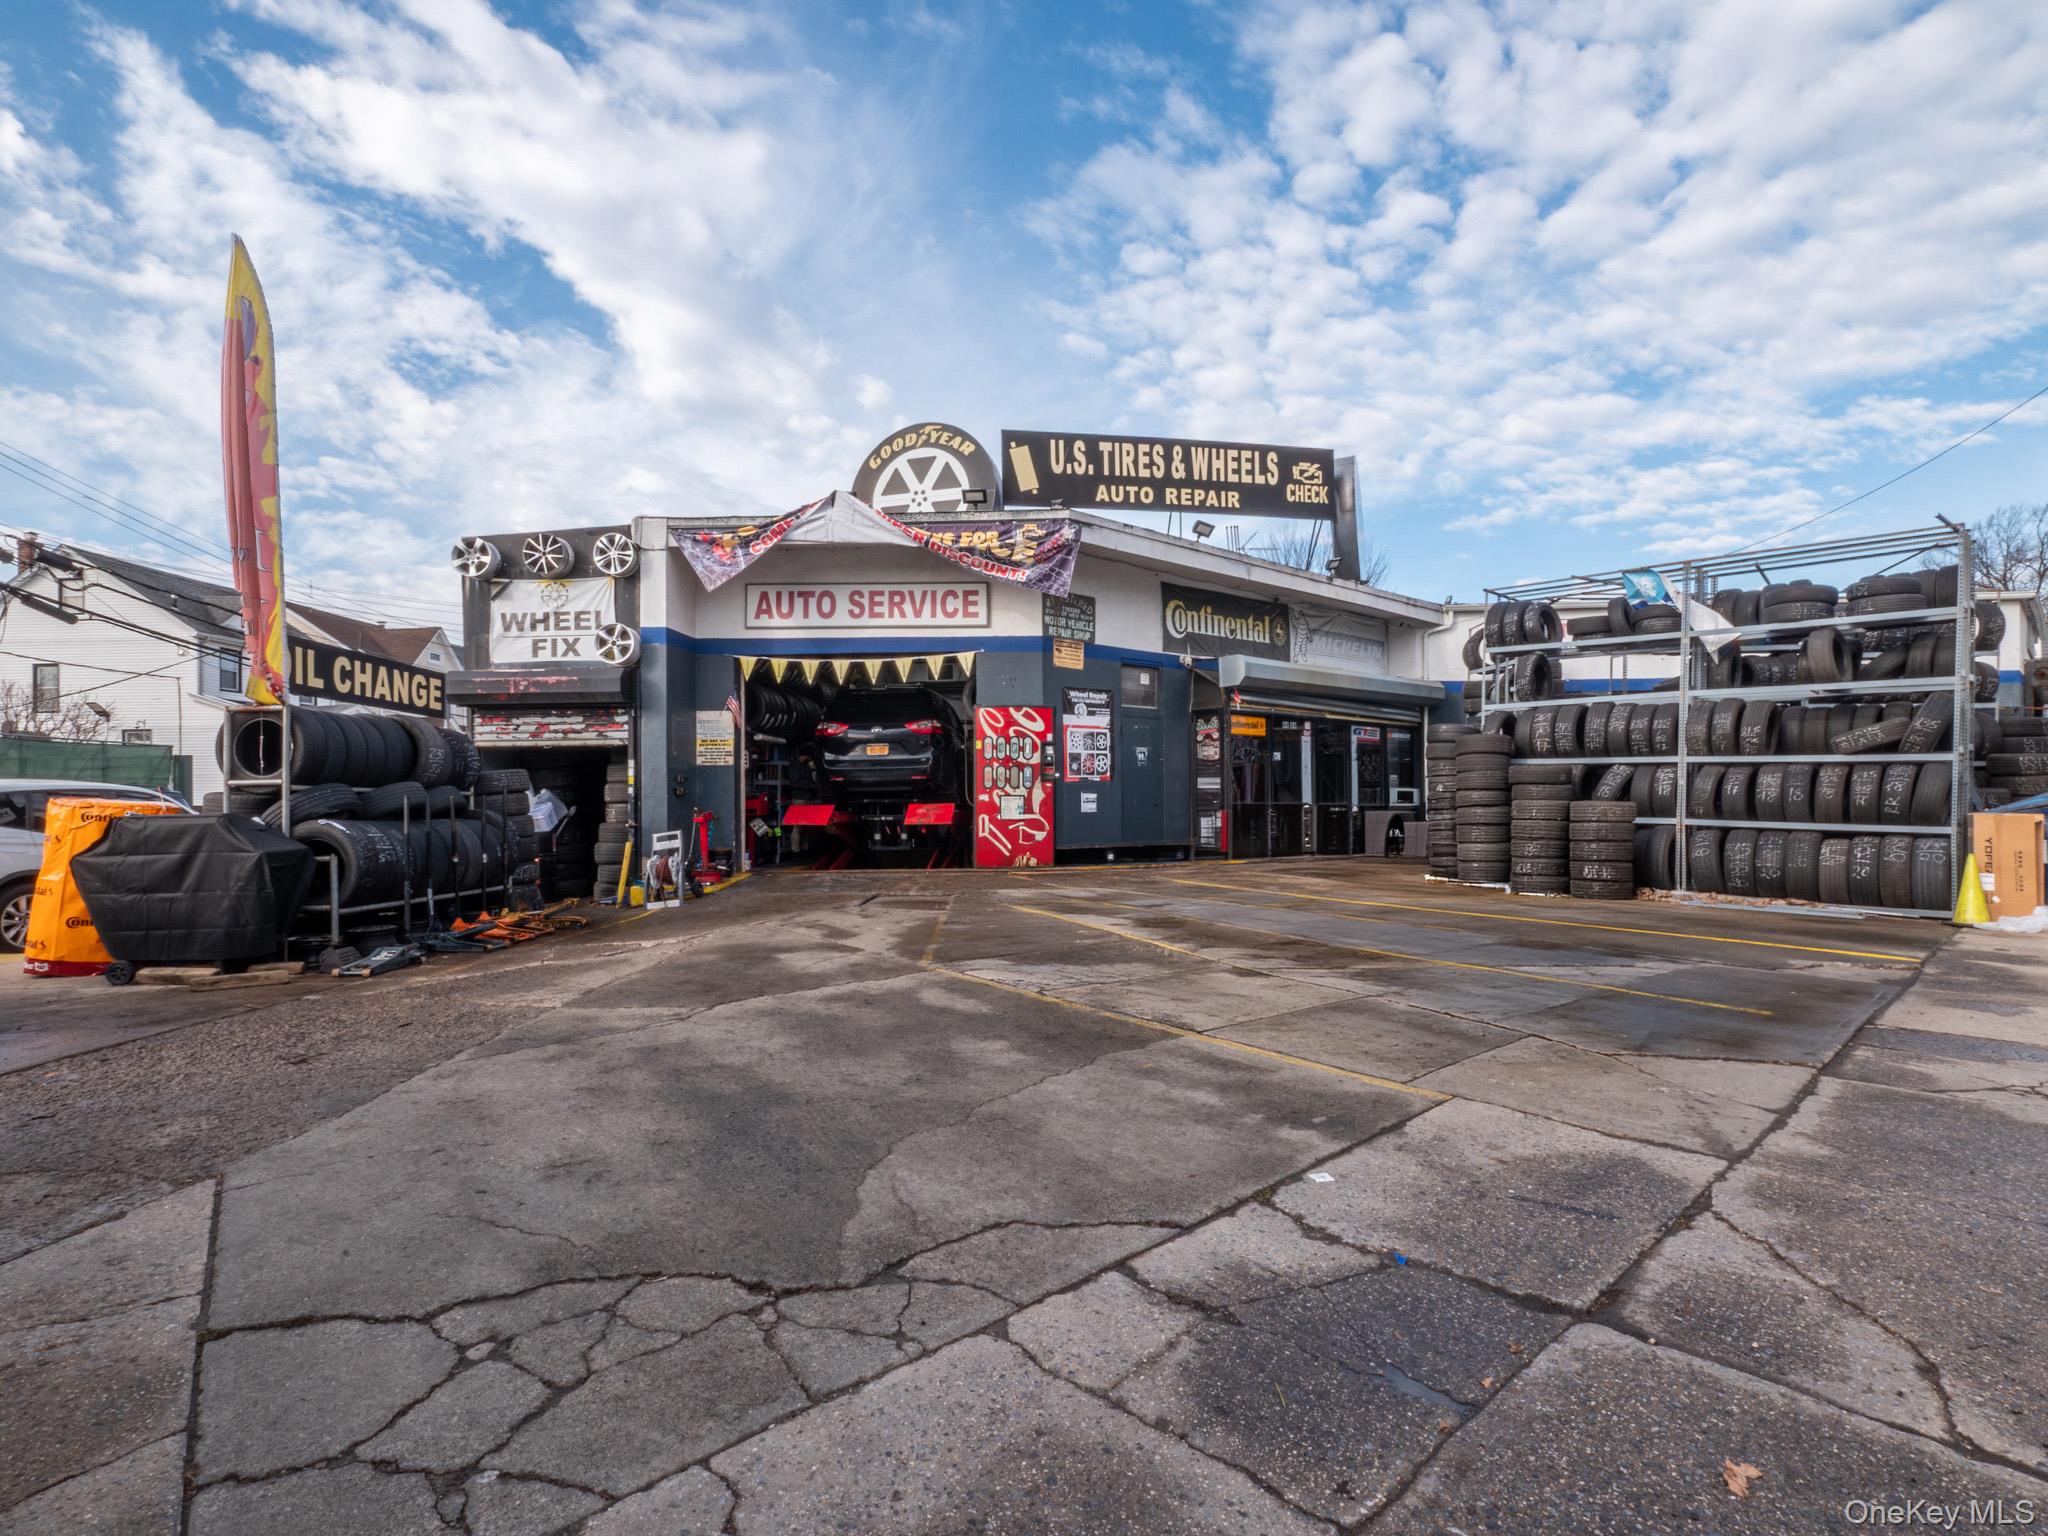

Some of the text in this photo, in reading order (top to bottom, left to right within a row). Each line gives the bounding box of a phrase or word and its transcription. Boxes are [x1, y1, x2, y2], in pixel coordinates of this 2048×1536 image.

[868, 429, 976, 471] GOODYEAR
[1049, 439, 1279, 487] U.S. TIRES & WHEELS
[1095, 483, 1241, 509] AUTO REPAIR
[1286, 483, 1329, 505] CHECK
[929, 538, 1029, 583] DISCOUNT!
[754, 588, 980, 620] AUTO SERVICE
[500, 610, 604, 633] WHEEL
[1044, 615, 1094, 632] MOTOR VEHICLE
[1048, 626, 1091, 641] REPAIR SHOP
[1165, 599, 1271, 644] Continental
[531, 638, 582, 658] FIX
[290, 646, 442, 711] IL CHANGE
